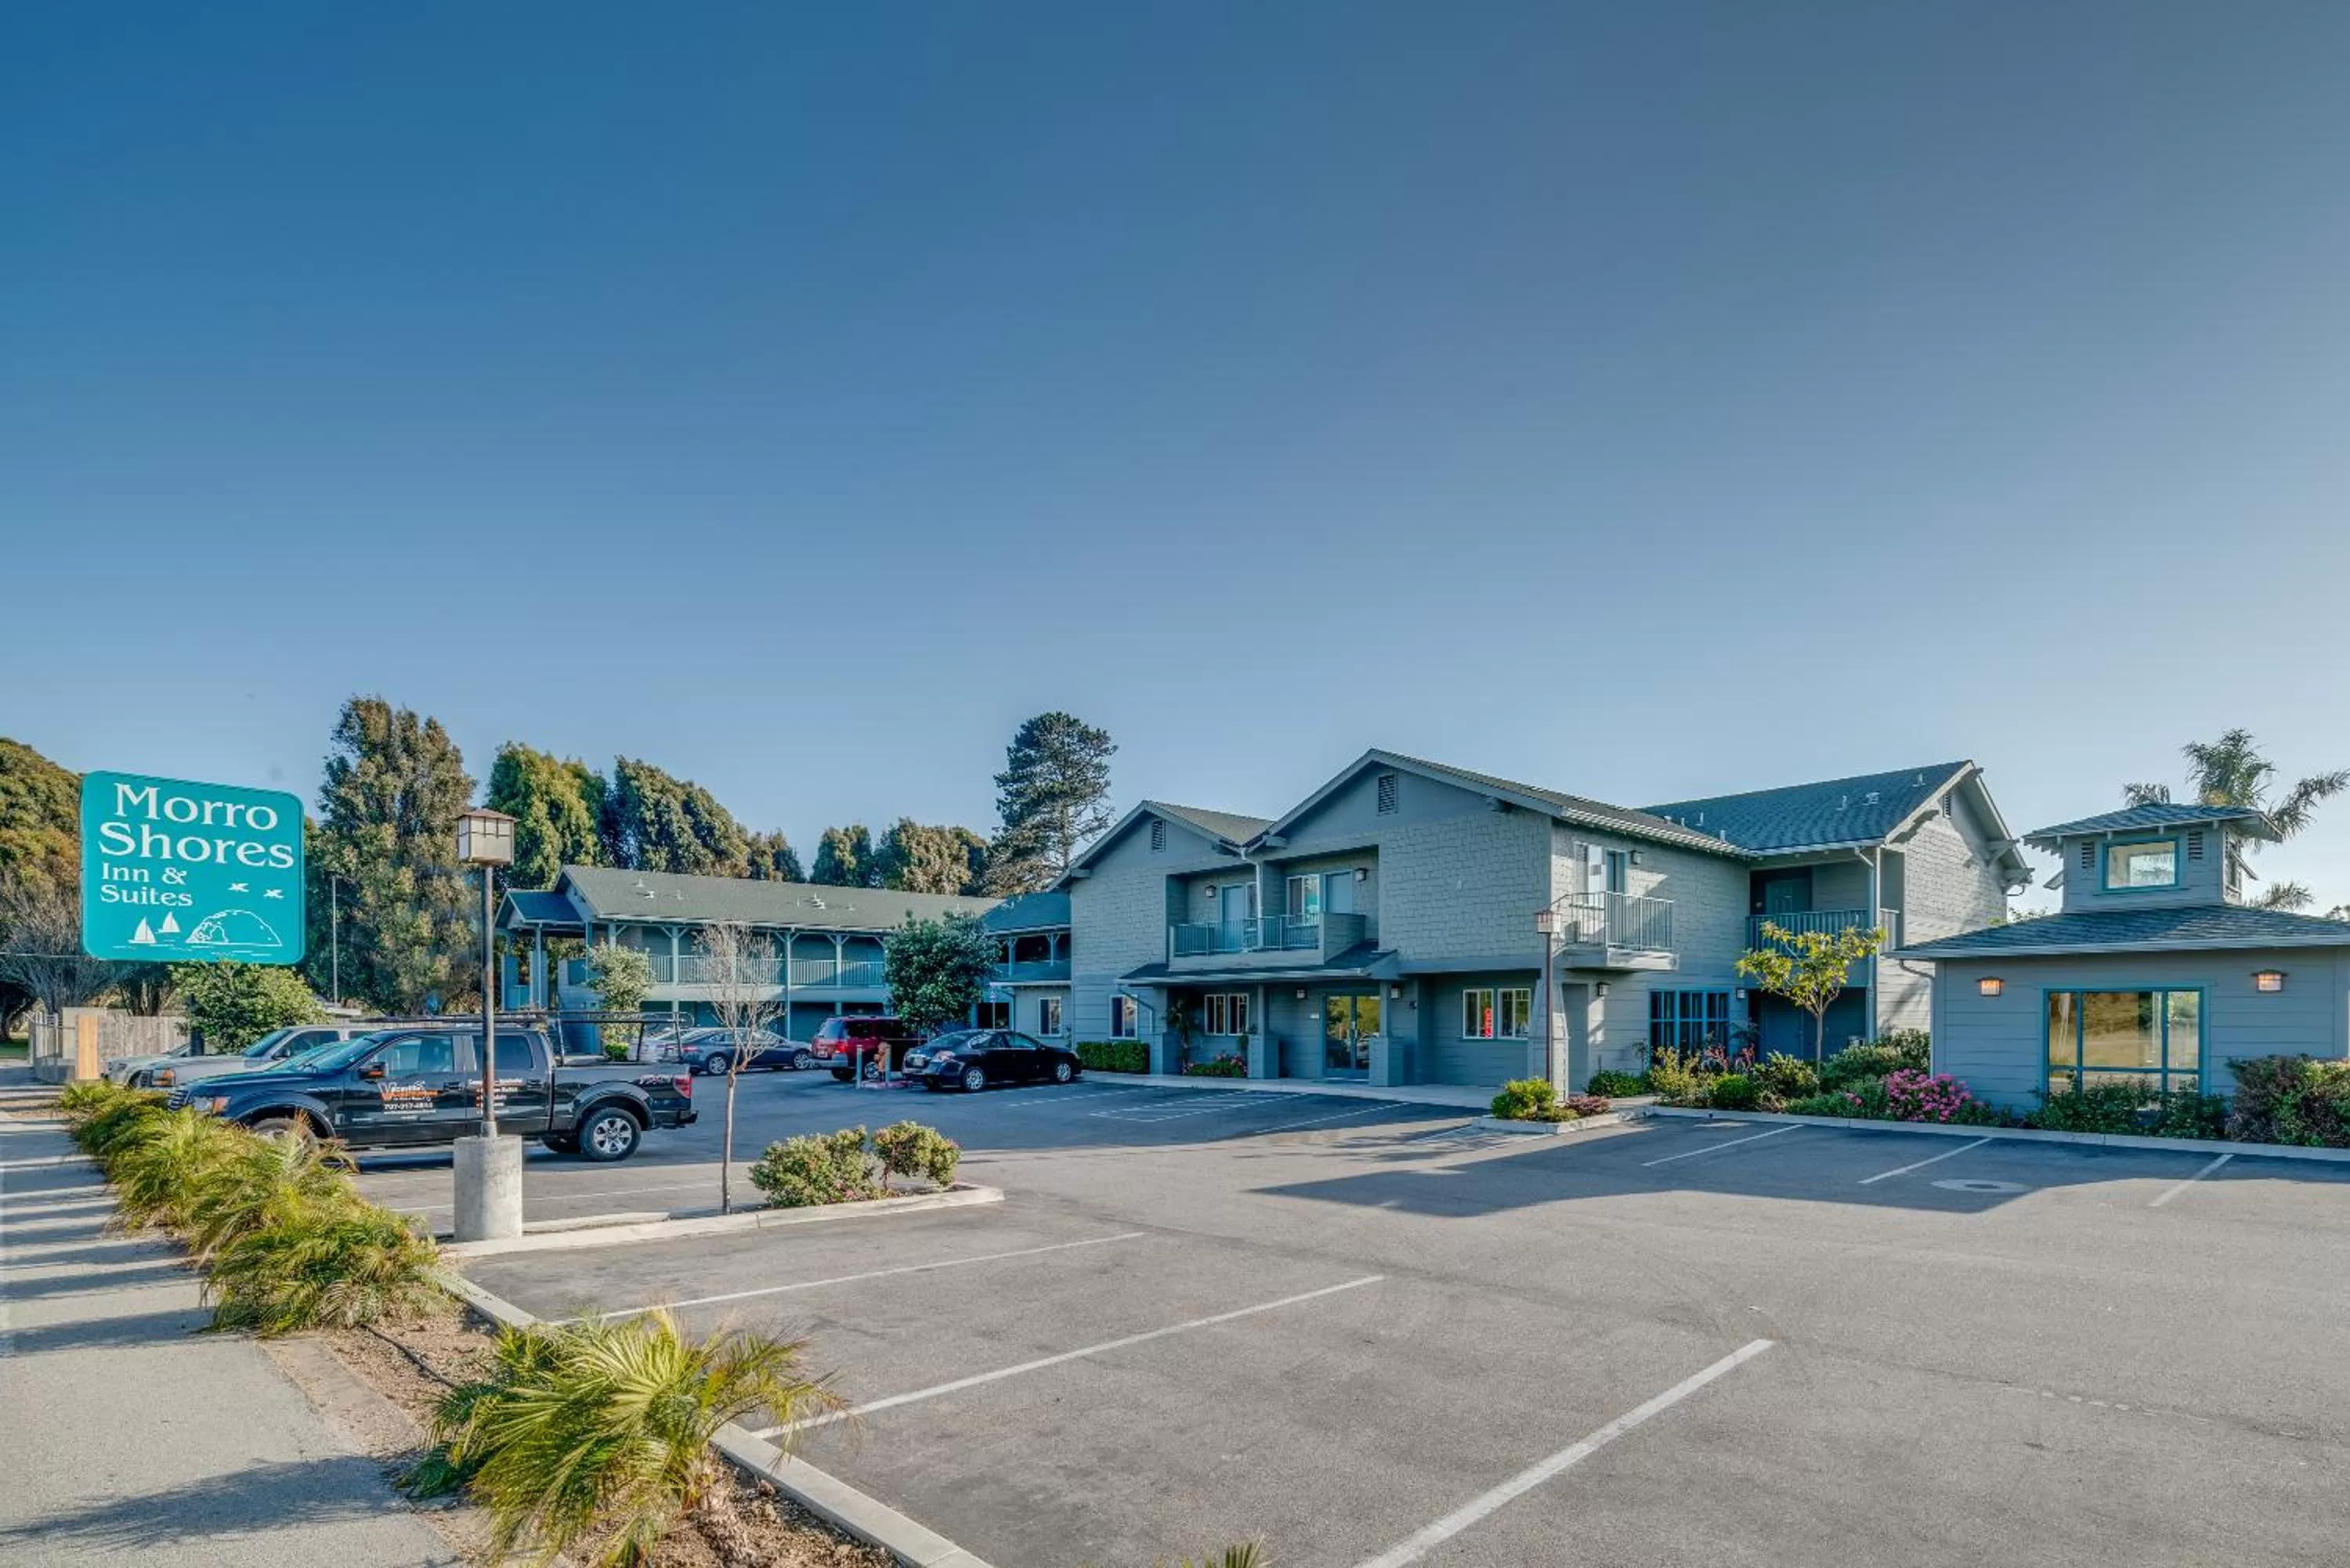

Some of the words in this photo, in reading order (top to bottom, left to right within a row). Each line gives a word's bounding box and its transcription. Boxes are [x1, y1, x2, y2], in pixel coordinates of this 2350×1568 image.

[114, 782, 278, 830] Morro
[99, 822, 294, 869] Shores
[102, 862, 150, 883] Inn
[161, 867, 187, 885] &
[100, 885, 193, 906] Suites
